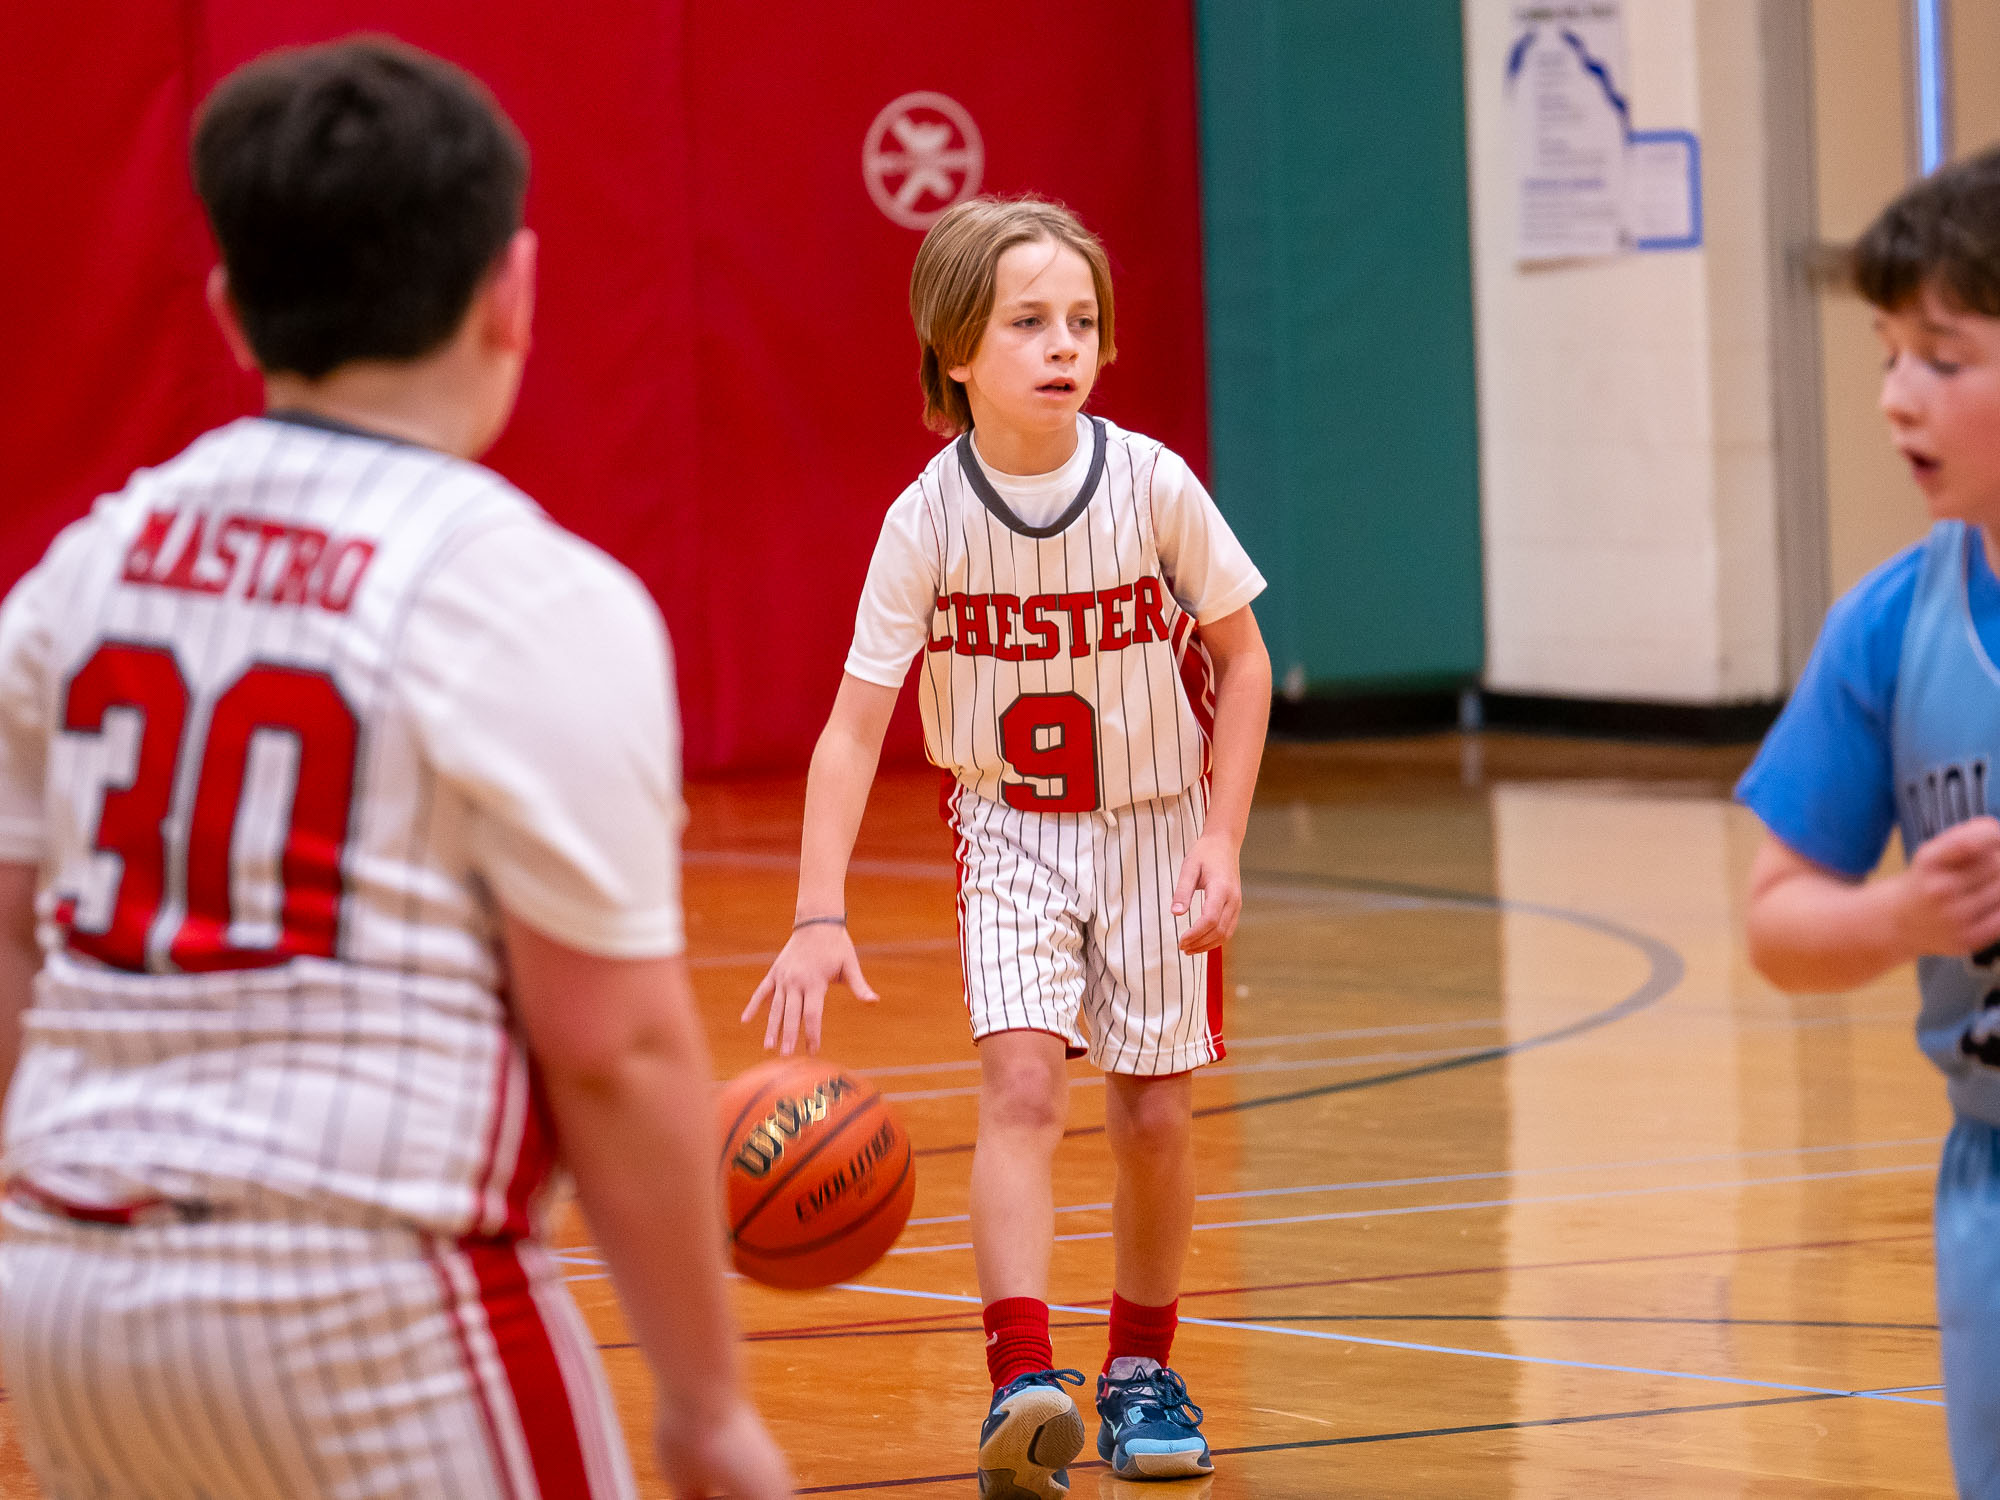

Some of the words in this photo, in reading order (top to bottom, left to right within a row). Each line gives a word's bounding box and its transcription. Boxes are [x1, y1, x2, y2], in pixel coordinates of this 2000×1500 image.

[926, 575, 1169, 662] CHESTER
[55, 634, 362, 976] 30
[998, 690, 1101, 813] 9
